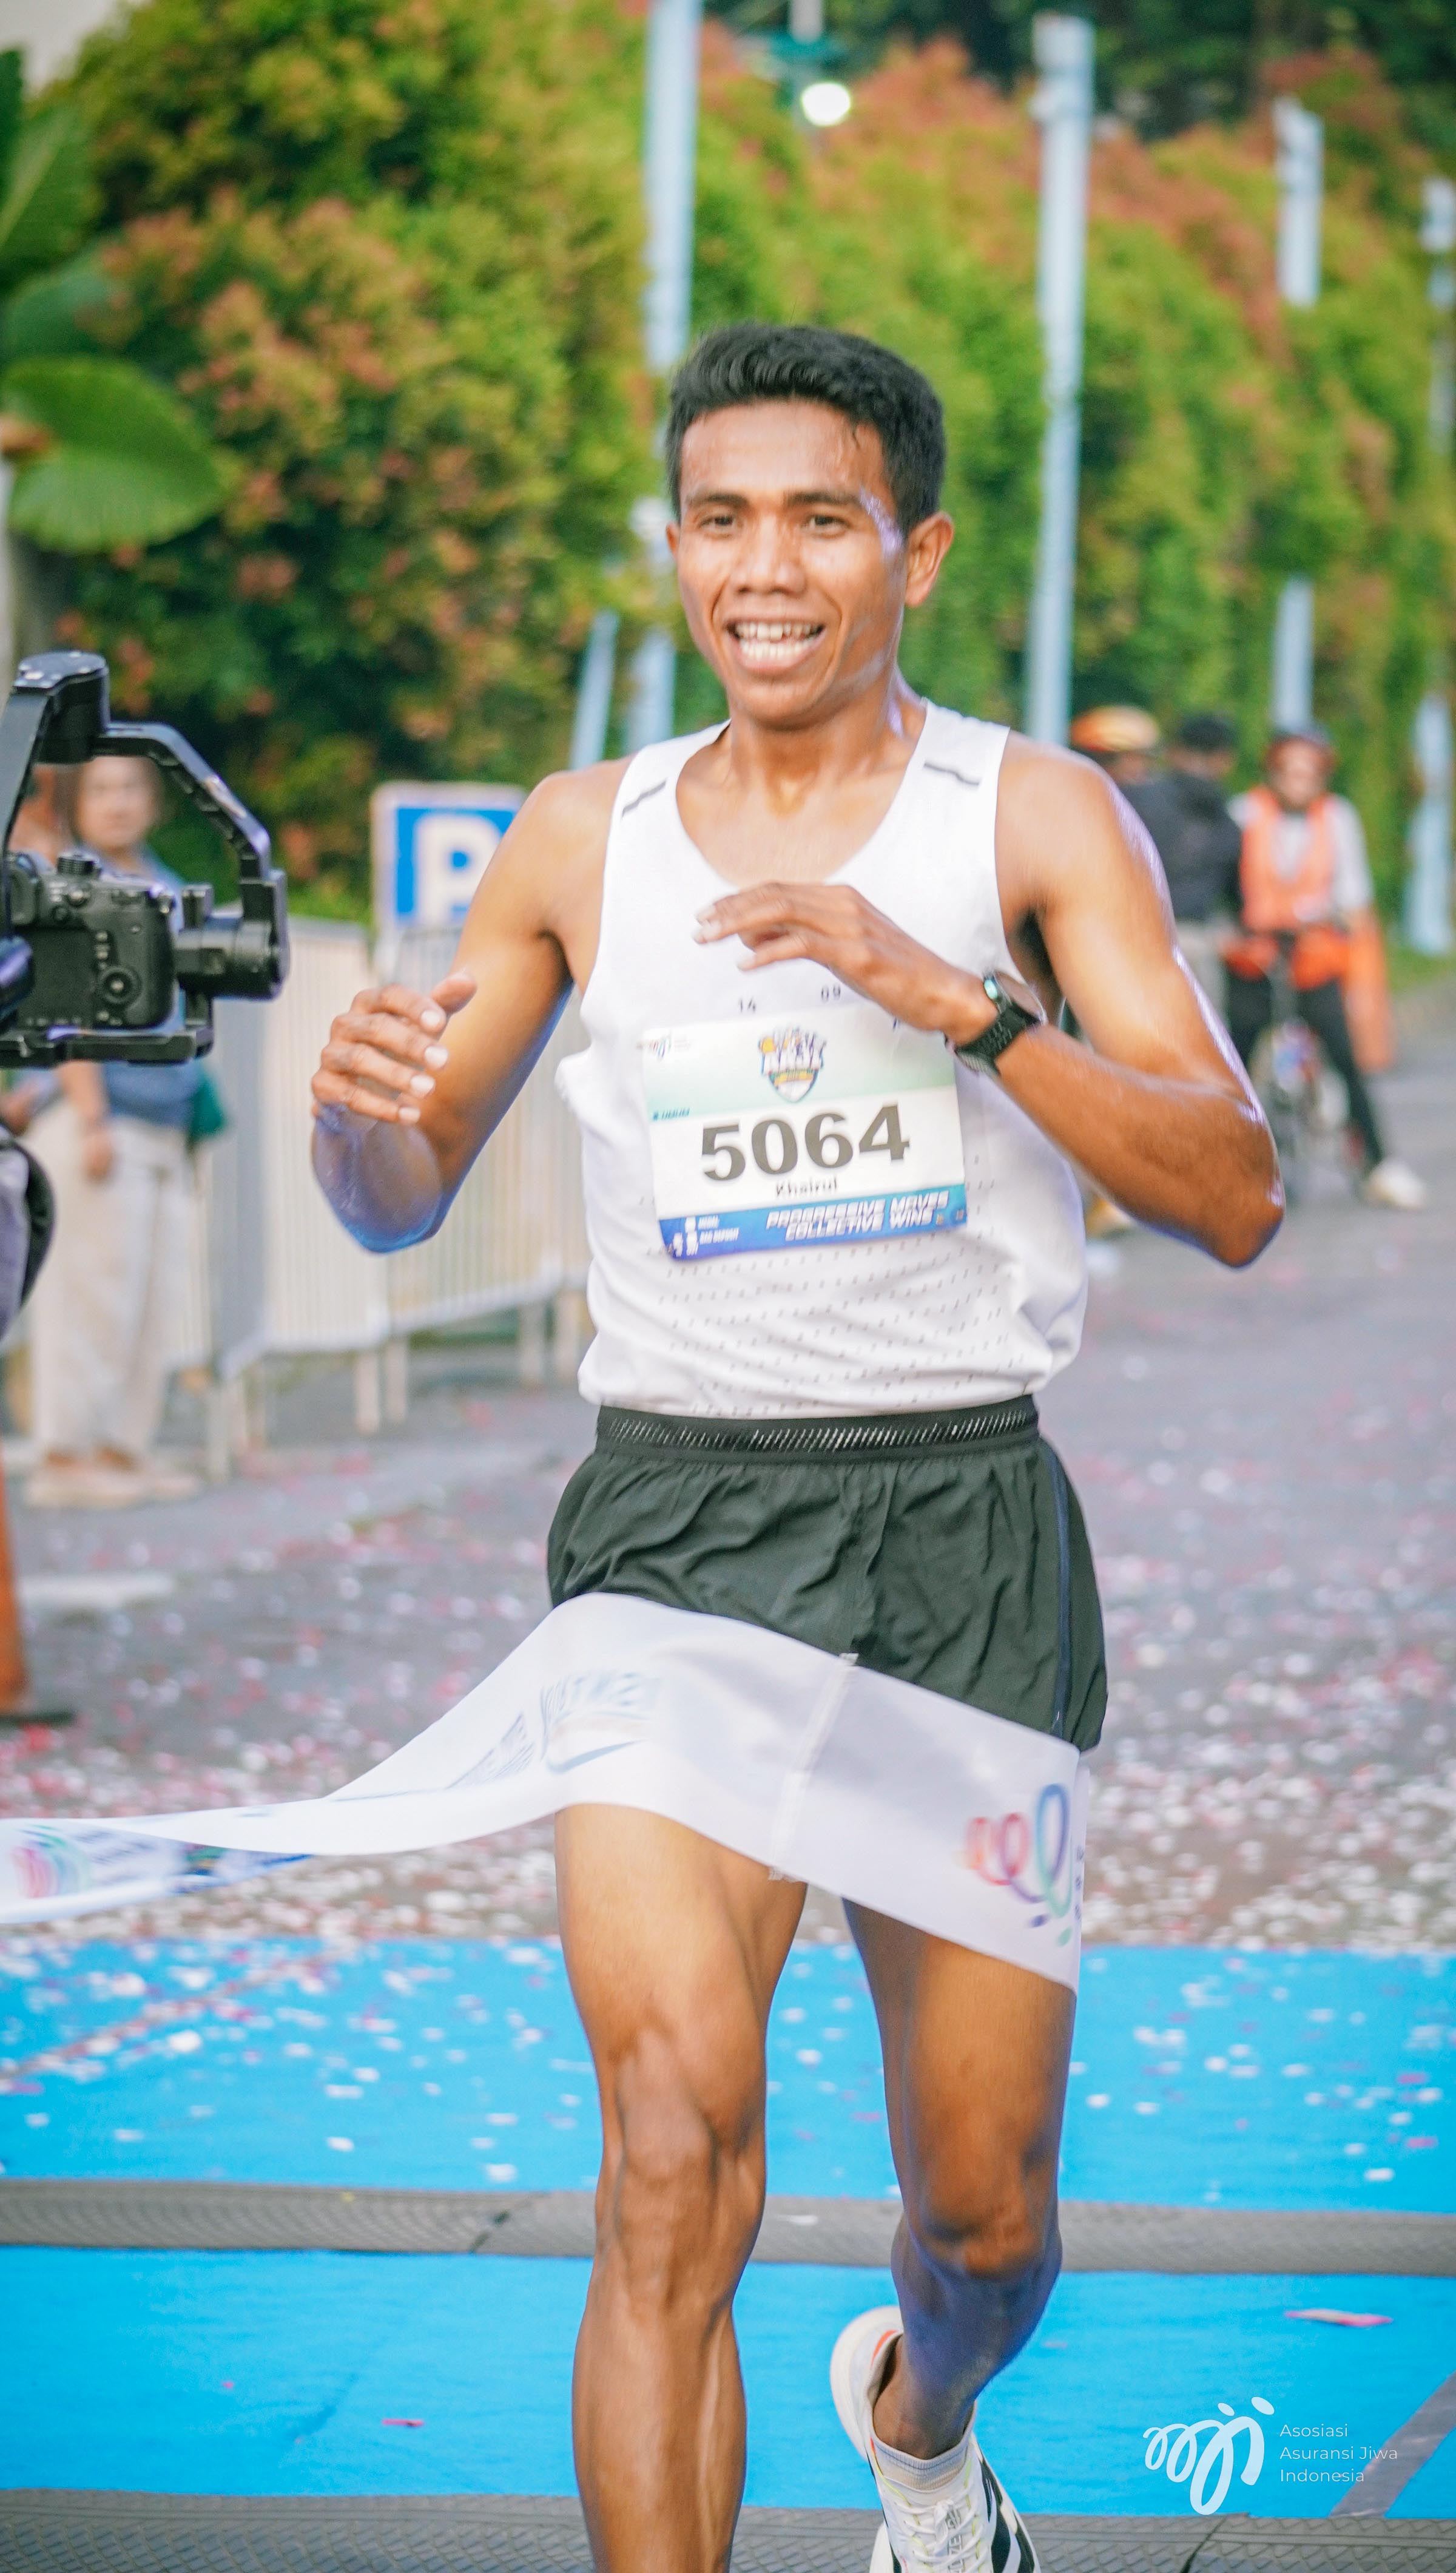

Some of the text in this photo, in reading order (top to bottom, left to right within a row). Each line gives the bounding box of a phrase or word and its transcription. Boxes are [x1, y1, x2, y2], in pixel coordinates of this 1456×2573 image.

[417, 814, 500, 928] P
[702, 1105, 909, 1181] 5064
[766, 1199, 886, 1229] PROGRESSIVE
[785, 1214, 884, 1242] COLLECTIVE
